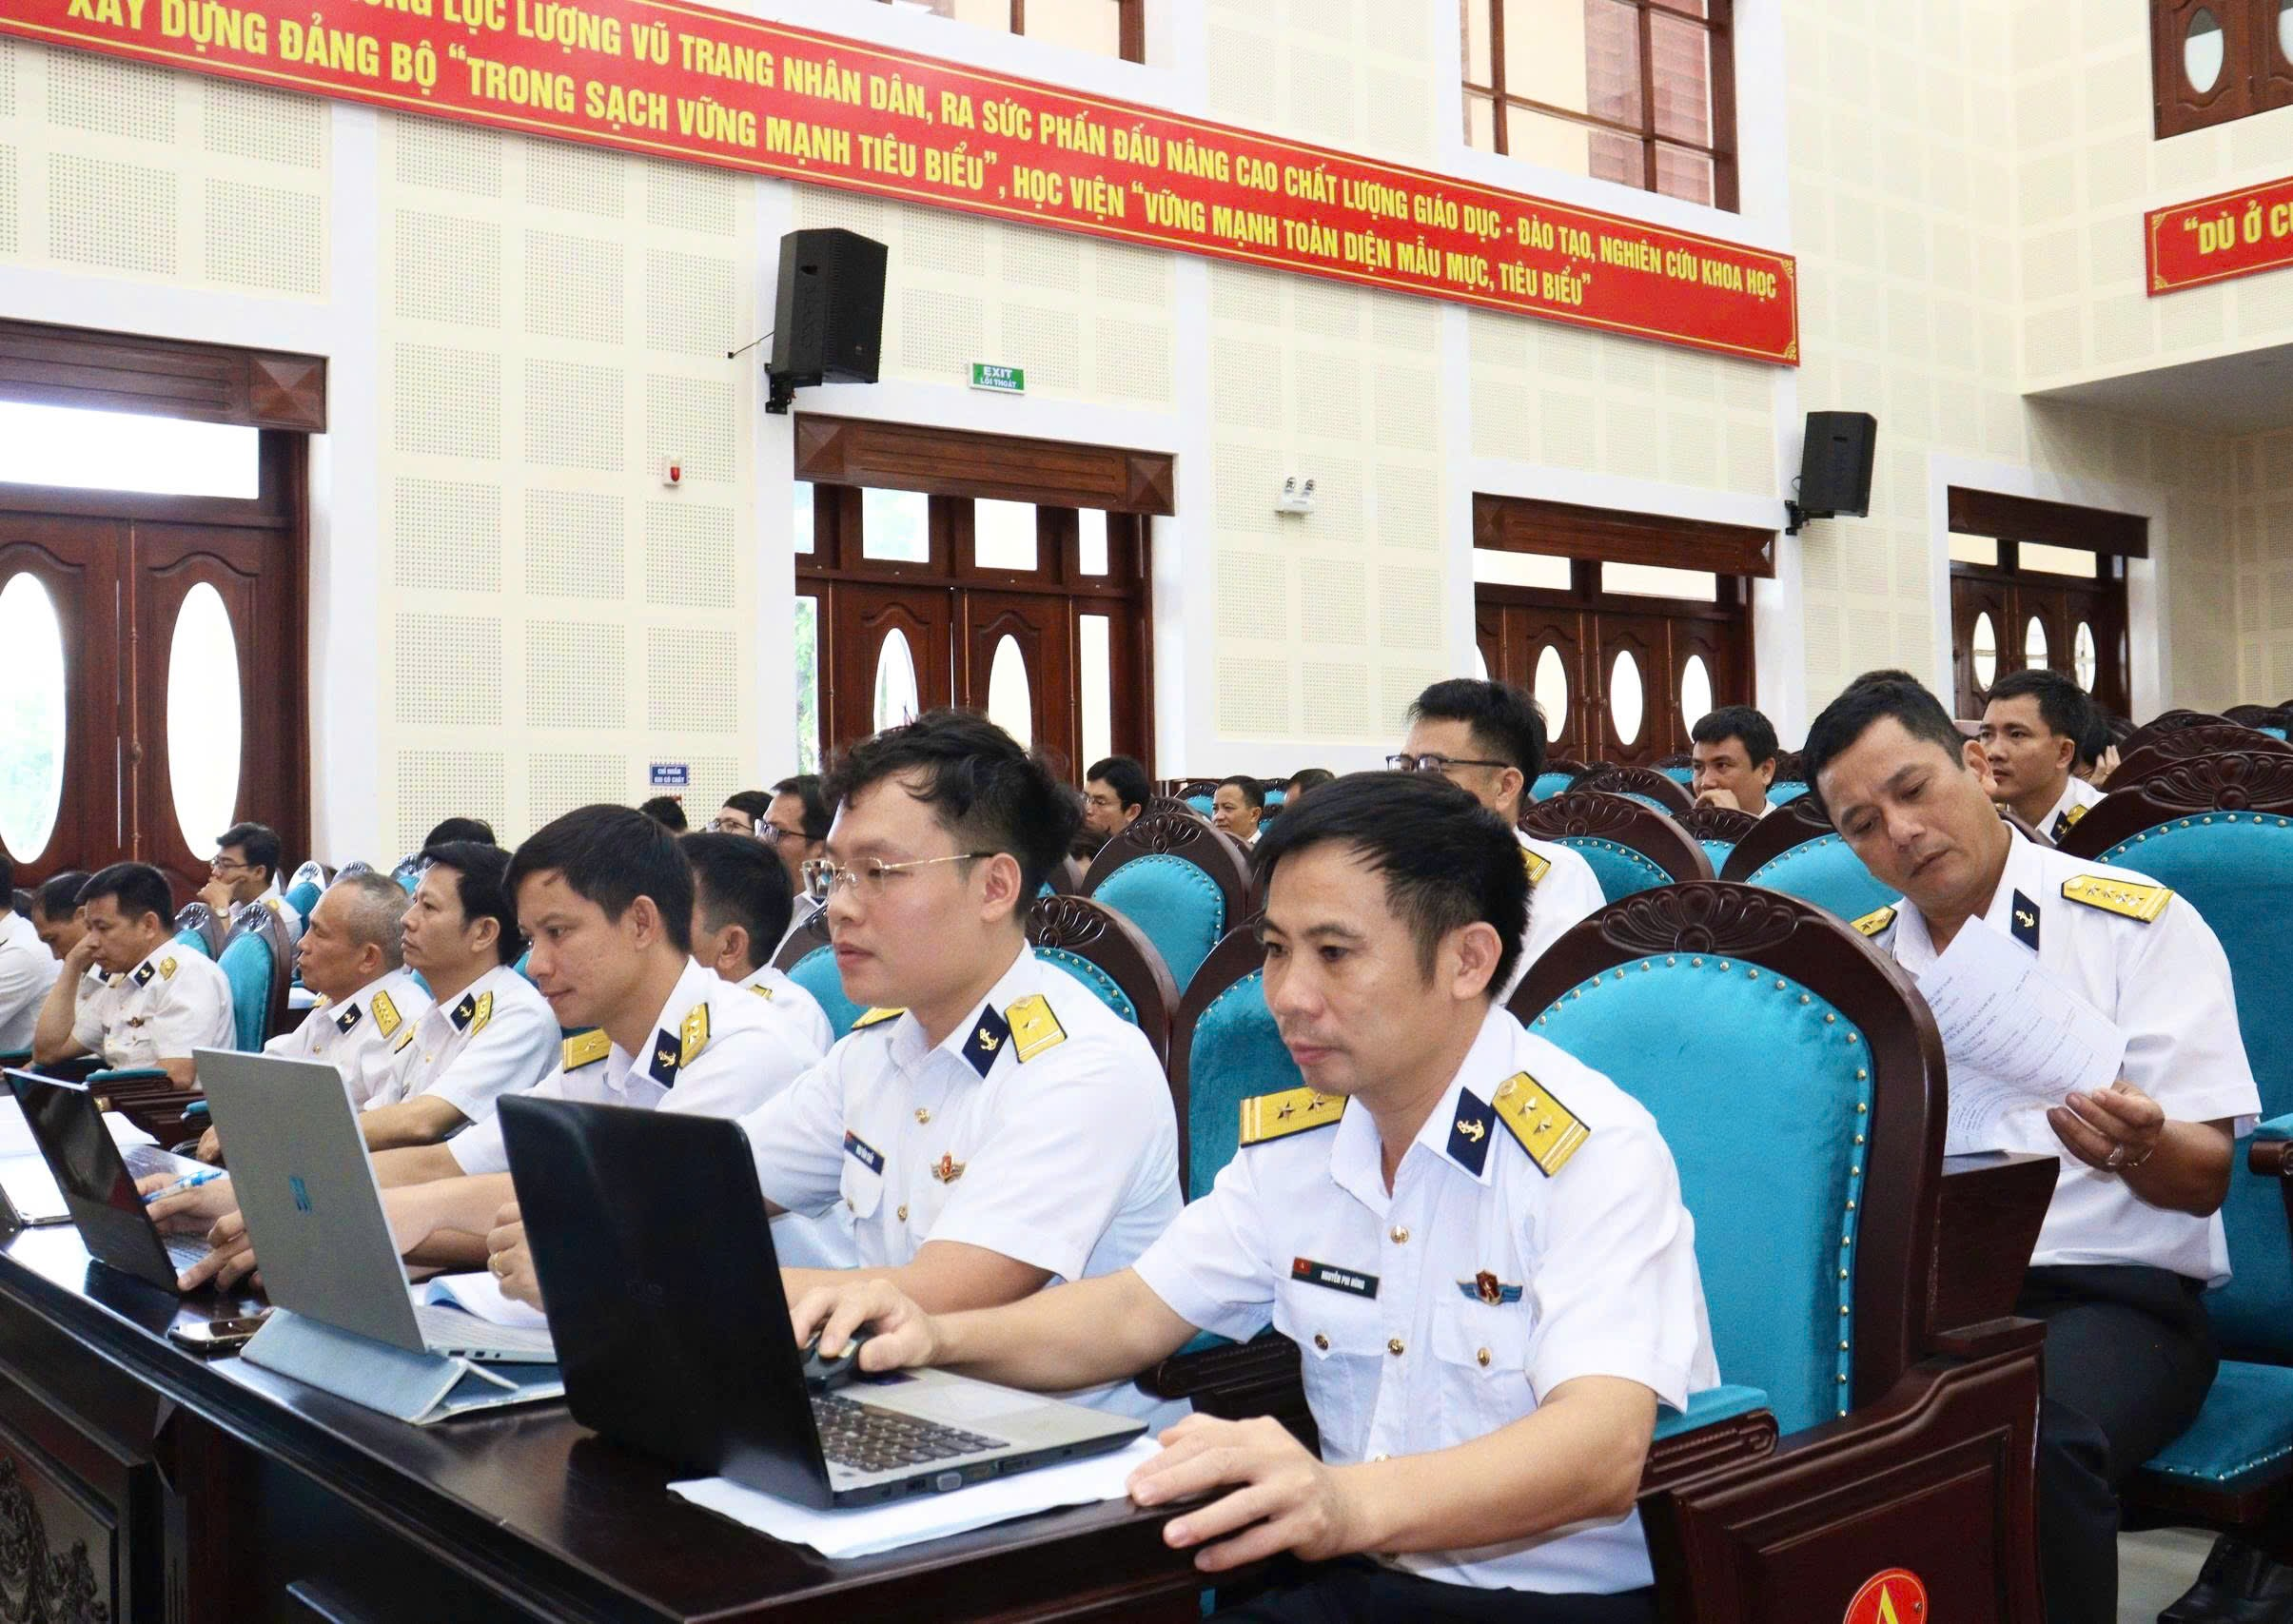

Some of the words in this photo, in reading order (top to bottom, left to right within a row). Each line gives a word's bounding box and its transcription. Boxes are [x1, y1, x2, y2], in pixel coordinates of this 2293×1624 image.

[161, 0, 268, 55] DỰNG
[278, 11, 380, 77] ĐẢNG
[390, 39, 437, 96] BỘ
[584, 80, 668, 132] SẠCH
[676, 95, 757, 148] VỮNG
[765, 115, 852, 166] MẠNH
[857, 131, 917, 178] TIÊU
[1012, 165, 1064, 210] HỌC
[1068, 174, 1125, 222] VIỆN
[1211, 205, 1278, 247] MẠNH
[1283, 219, 1339, 259] TOÀN
[1343, 229, 1391, 272] DIỆN
[1397, 235, 1441, 278] MẪU
[1445, 252, 1495, 291] MỰC,
[1498, 261, 1538, 297] TIÊU
[516, 0, 622, 56] LƯỢNG
[630, 18, 671, 66] VŨ
[677, 32, 775, 88] TRANG
[783, 55, 862, 107] NHÂN
[869, 72, 933, 126] DÂN,
[940, 90, 975, 130] RA
[982, 97, 1033, 142] SỨC
[1039, 109, 1107, 157] PHẤN
[1111, 123, 1161, 168] ĐẤU
[1166, 137, 1230, 183] NÂNG
[1235, 155, 1279, 192] CAO
[1284, 163, 1338, 205] CHẤT
[1342, 178, 1408, 221] LƯỢNG
[1413, 193, 1459, 230] GIÁO
[1463, 205, 1501, 243] DỤC
[1518, 214, 1555, 251] ĐÀO
[1558, 225, 1596, 264] TẠO,
[1599, 235, 1662, 274] NGHIÊN
[1665, 247, 1698, 282] CỨU
[1701, 258, 1743, 291] KHOA
[1746, 268, 1776, 303] HỌC
[2244, 199, 2263, 244] Ở
[2269, 201, 2293, 238] C
[983, 365, 1013, 379] EXIT
